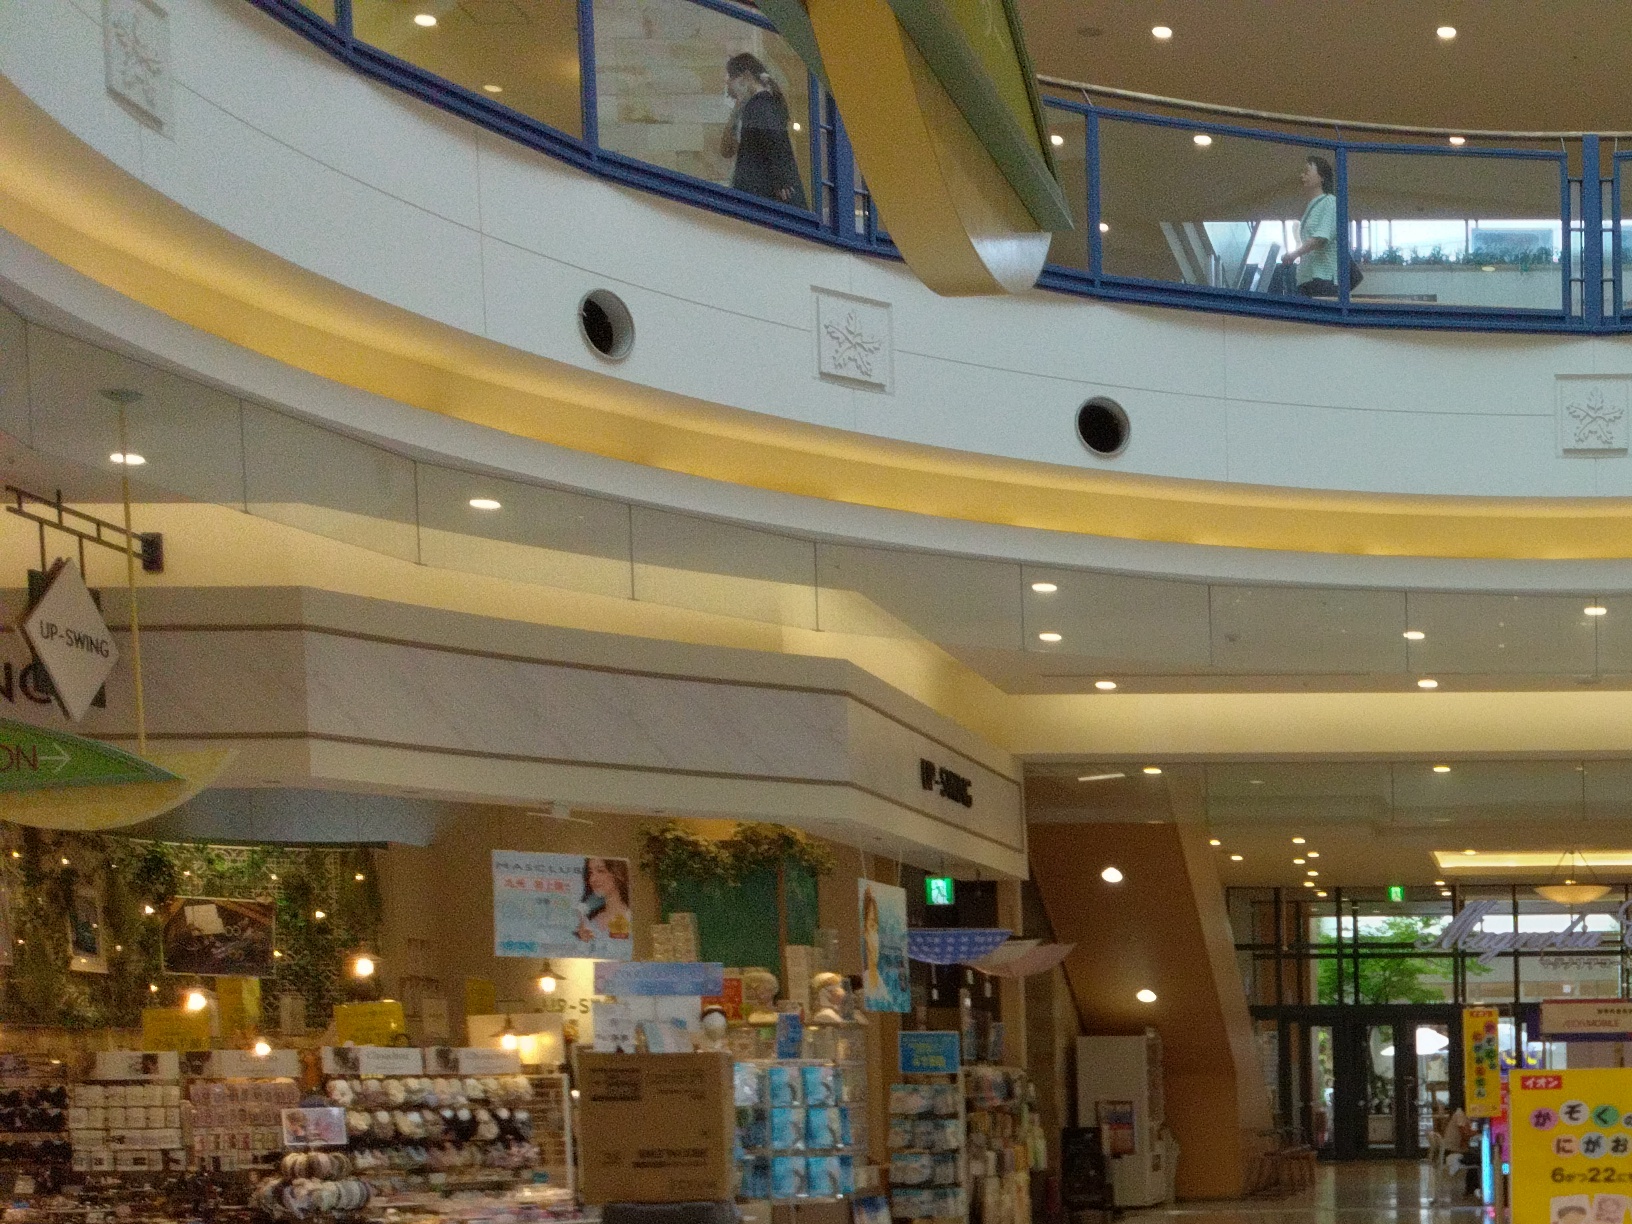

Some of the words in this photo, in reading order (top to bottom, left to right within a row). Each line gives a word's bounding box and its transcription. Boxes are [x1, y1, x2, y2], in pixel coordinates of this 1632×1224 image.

[38, 618, 110, 659] UP-SWING
[1413, 899, 1602, 964] Magnolia
[1524, 1077, 1559, 1089] イオン
